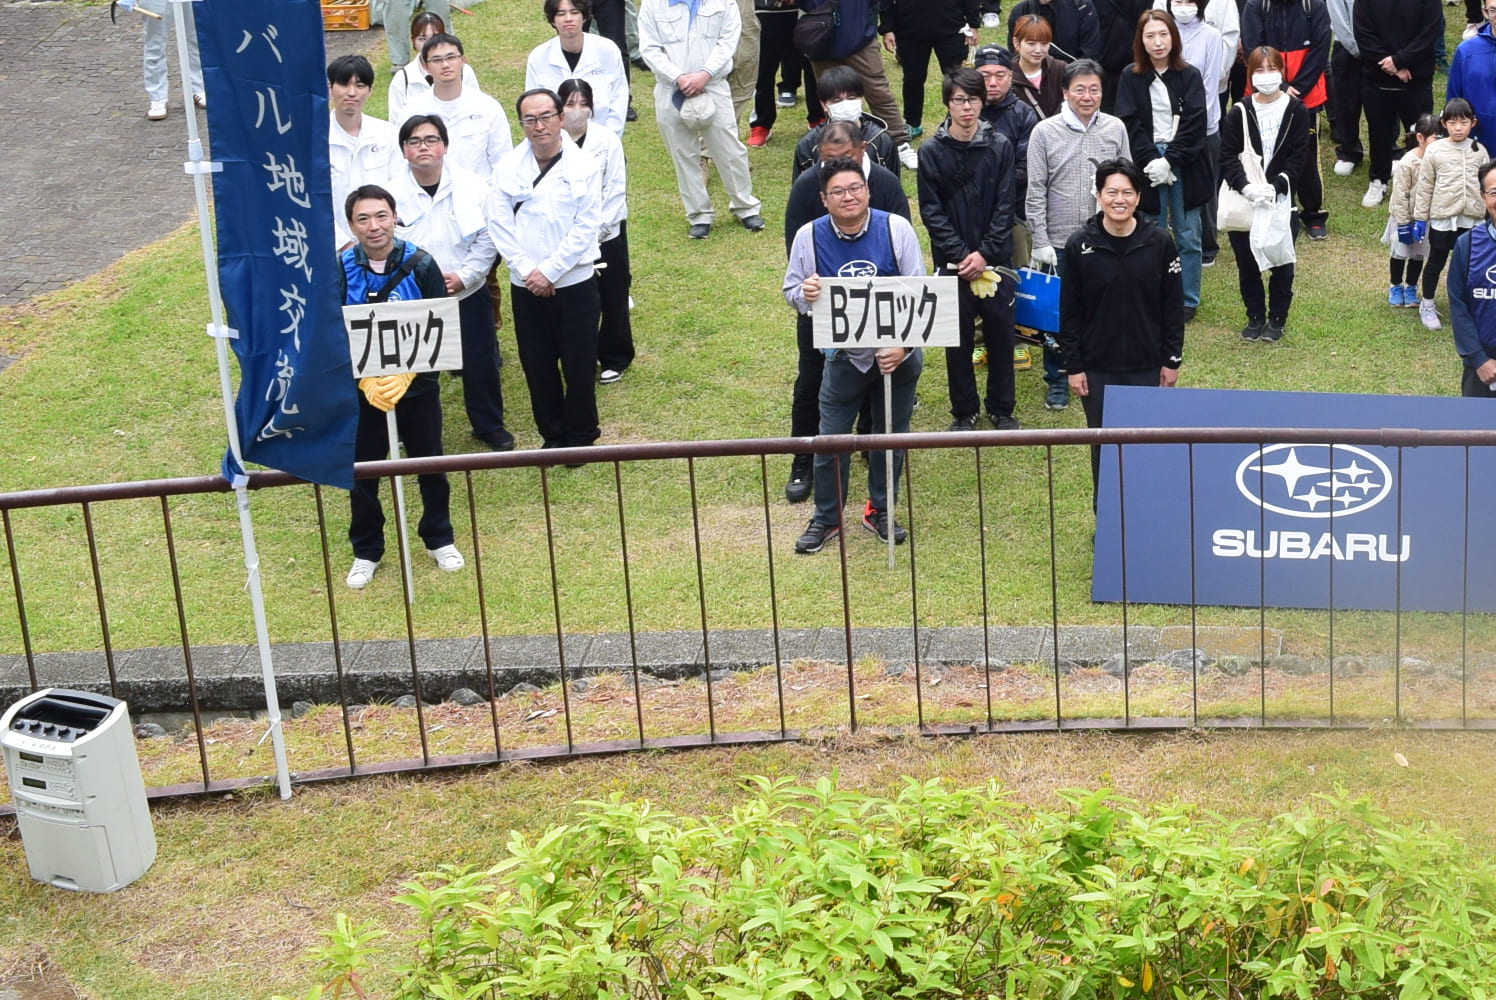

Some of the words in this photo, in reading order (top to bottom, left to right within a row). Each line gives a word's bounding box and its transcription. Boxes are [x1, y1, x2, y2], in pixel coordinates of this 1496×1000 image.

[350, 309, 445, 375] ブロック
[831, 283, 938, 344] Bブロック
[1212, 529, 1410, 562] SUBARU
